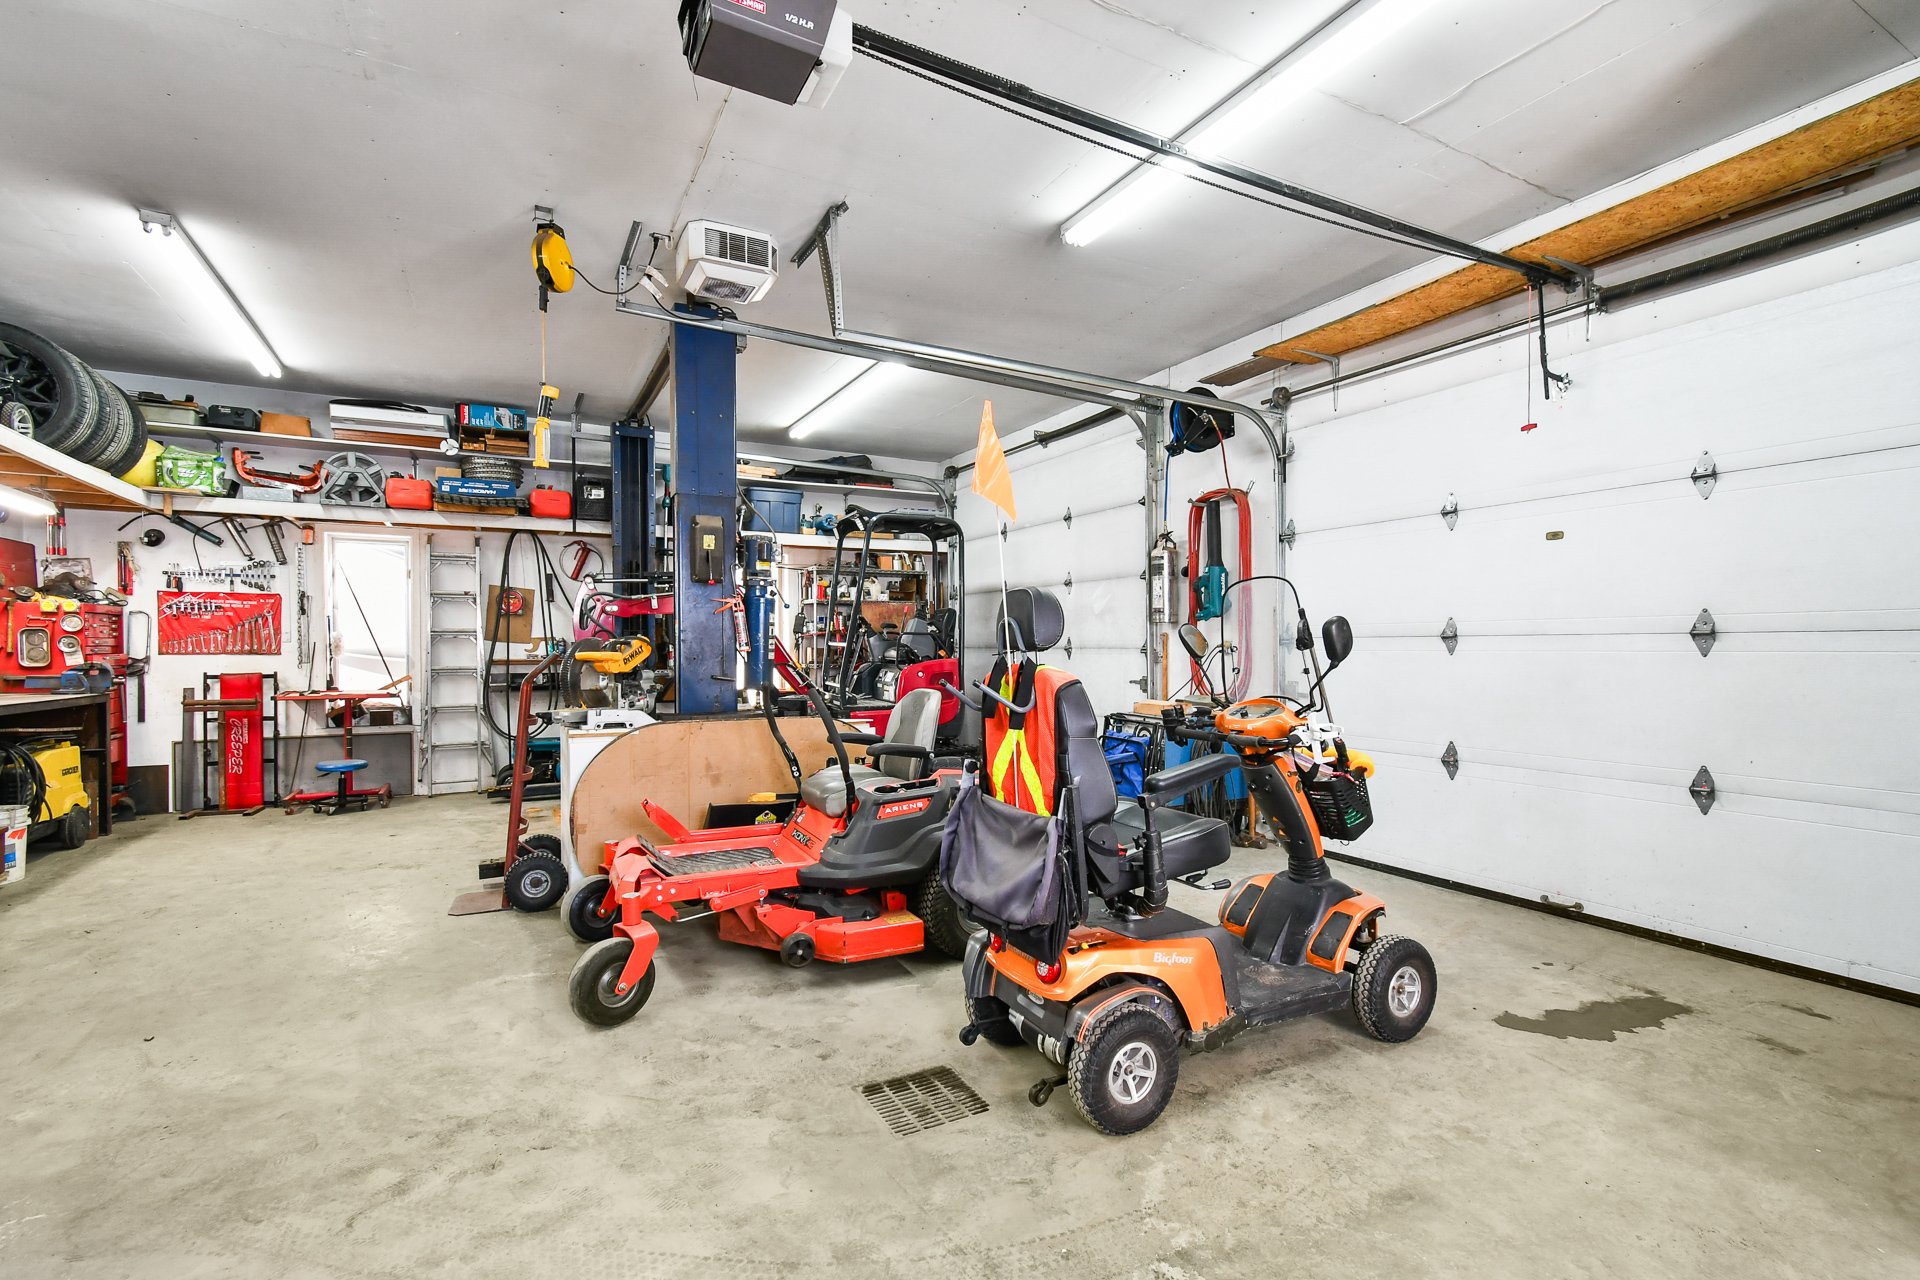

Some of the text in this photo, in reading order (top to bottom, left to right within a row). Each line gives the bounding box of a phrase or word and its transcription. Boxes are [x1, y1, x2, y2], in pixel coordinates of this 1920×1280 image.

[784, 13, 798, 24] 1/2
[229, 718, 243, 775] CREEPER
[884, 801, 924, 814] ARIENS
